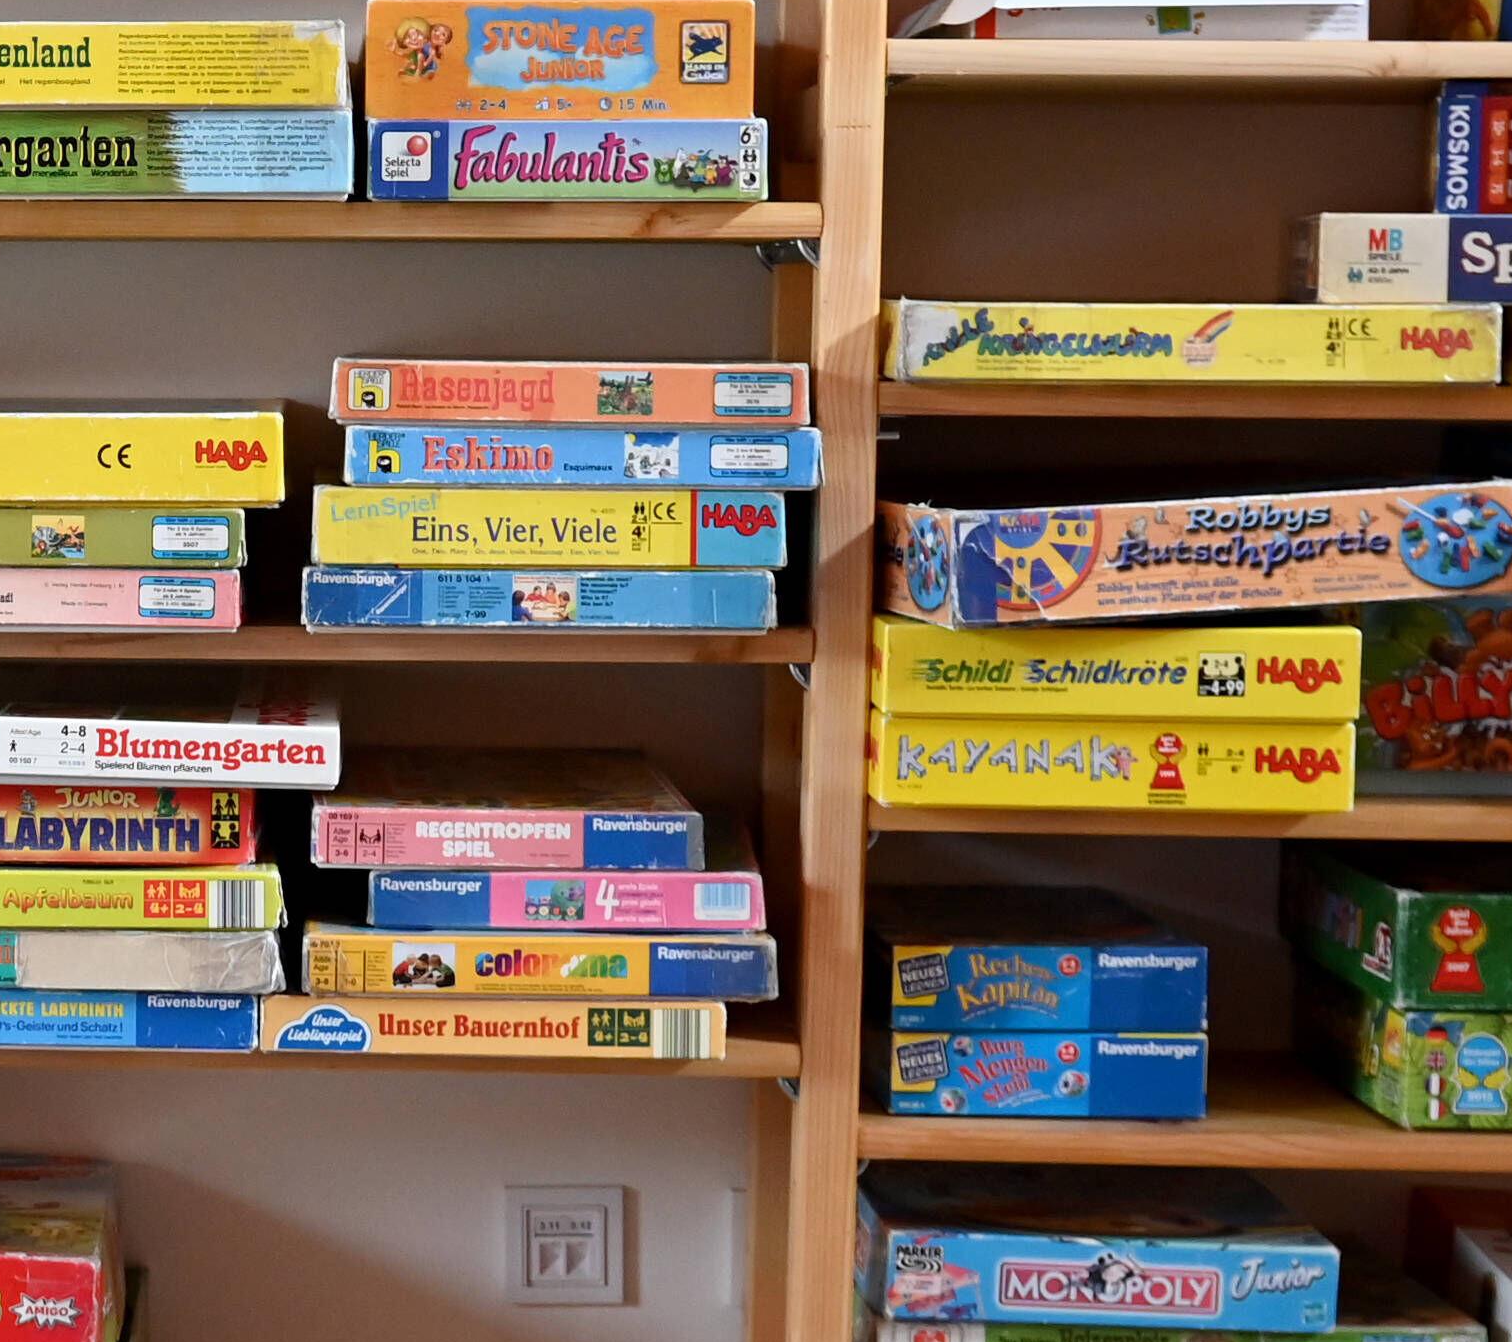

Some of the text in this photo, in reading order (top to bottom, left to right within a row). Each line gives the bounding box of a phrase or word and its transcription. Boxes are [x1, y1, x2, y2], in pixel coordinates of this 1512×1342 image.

[483, 20, 644, 57] STONE AGE
[520, 57, 605, 81] JUNIOR
[385, 158, 420, 167] Selecta
[455, 125, 649, 190] Fabulantis
[1447, 104, 1469, 209] KOSMOS
[385, 167, 408, 178] Spiel
[195, 439, 267, 471] HABA
[422, 437, 552, 471] Eskimo
[412, 518, 617, 543] Eins, Vier, Viele
[1186, 504, 1330, 531] Robbys
[1118, 530, 1391, 574] Rutschpartie
[925, 658, 1187, 685] Schildi Schildkröte
[1258, 658, 1341, 692] HABA
[95, 729, 326, 769] Blumengarten
[55, 789, 138, 809] JUNIOR
[415, 822, 570, 840] REGENTROPFEN
[443, 843, 494, 858] SPIEL
[3, 887, 134, 912] Apfelbaum
[379, 1014, 581, 1040] Unser Bauernhof
[1006, 1260, 1323, 1307] MONOPOLY Junior
